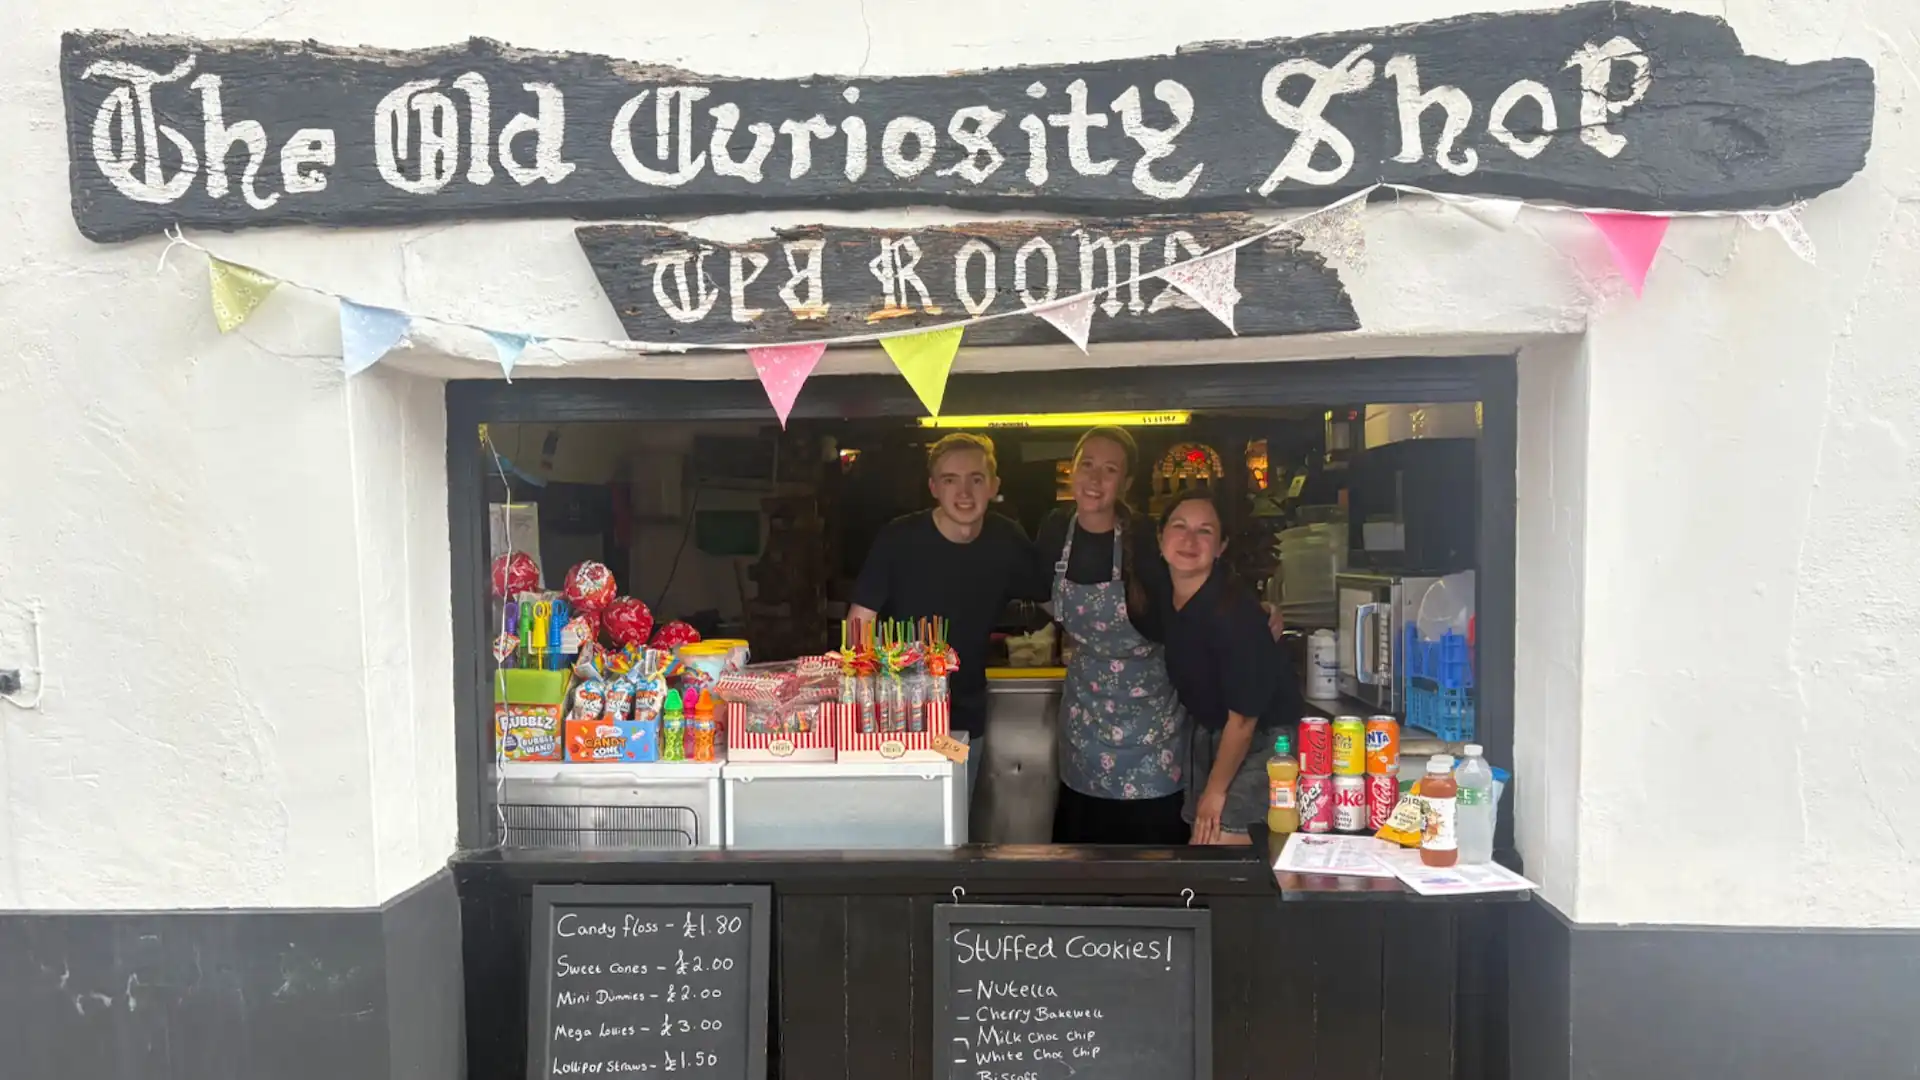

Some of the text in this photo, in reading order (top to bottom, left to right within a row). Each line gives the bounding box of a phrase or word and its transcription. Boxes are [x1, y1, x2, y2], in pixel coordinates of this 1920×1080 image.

[81, 34, 1651, 210] The Old Curiosity Shop
[1331, 789, 1365, 806] oke
[557, 913, 616, 938] Candy
[683, 911, 741, 938] £1.80
[557, 955, 601, 977] Sweet
[675, 949, 733, 975] £2.00
[556, 991, 589, 1008] Mini
[596, 989, 644, 1004] Dummies
[976, 1006, 1103, 1023] Cherry Bakewell
[555, 1025, 592, 1041] Mega
[977, 1025, 1021, 1046] Milk
[665, 1051, 717, 1071] £1.50
[976, 1051, 1023, 1065] White
